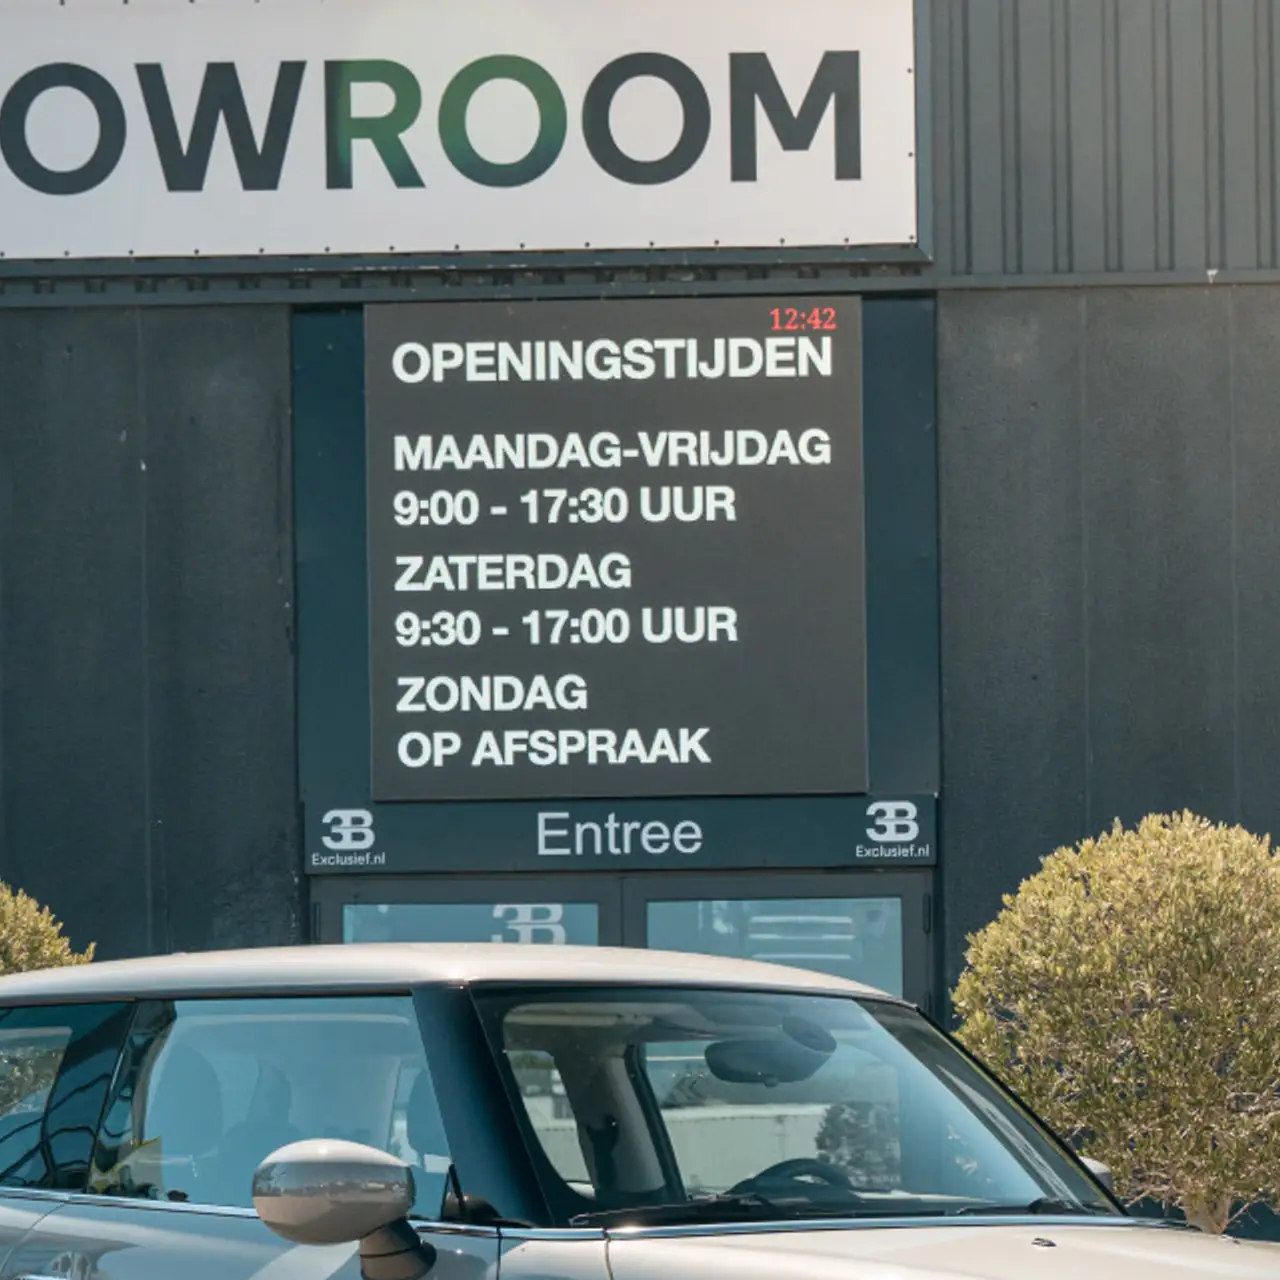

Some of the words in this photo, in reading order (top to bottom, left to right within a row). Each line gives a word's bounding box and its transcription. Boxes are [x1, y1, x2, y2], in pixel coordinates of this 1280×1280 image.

[769, 307, 837, 330] 12:42
[392, 336, 833, 384] OPENINGSTIJDEN
[393, 428, 832, 472] MAANDAG-VRIJDAG
[393, 489, 480, 526] 9:00
[520, 487, 629, 525] 17:30
[640, 485, 737, 523] UUR
[394, 552, 632, 592] ZATERDAG
[395, 610, 481, 647] 9:30
[522, 607, 630, 645] 17:00
[642, 606, 739, 643] UUR
[396, 674, 588, 713] ZONDAG
[397, 731, 462, 768] OP
[471, 727, 712, 766] AFSPRAAK
[322, 809, 375, 850] 3B
[537, 812, 704, 856] Entree
[865, 801, 919, 842] 3B
[312, 852, 386, 866] Exclusief.nl
[855, 843, 930, 858] Exclusief.nl
